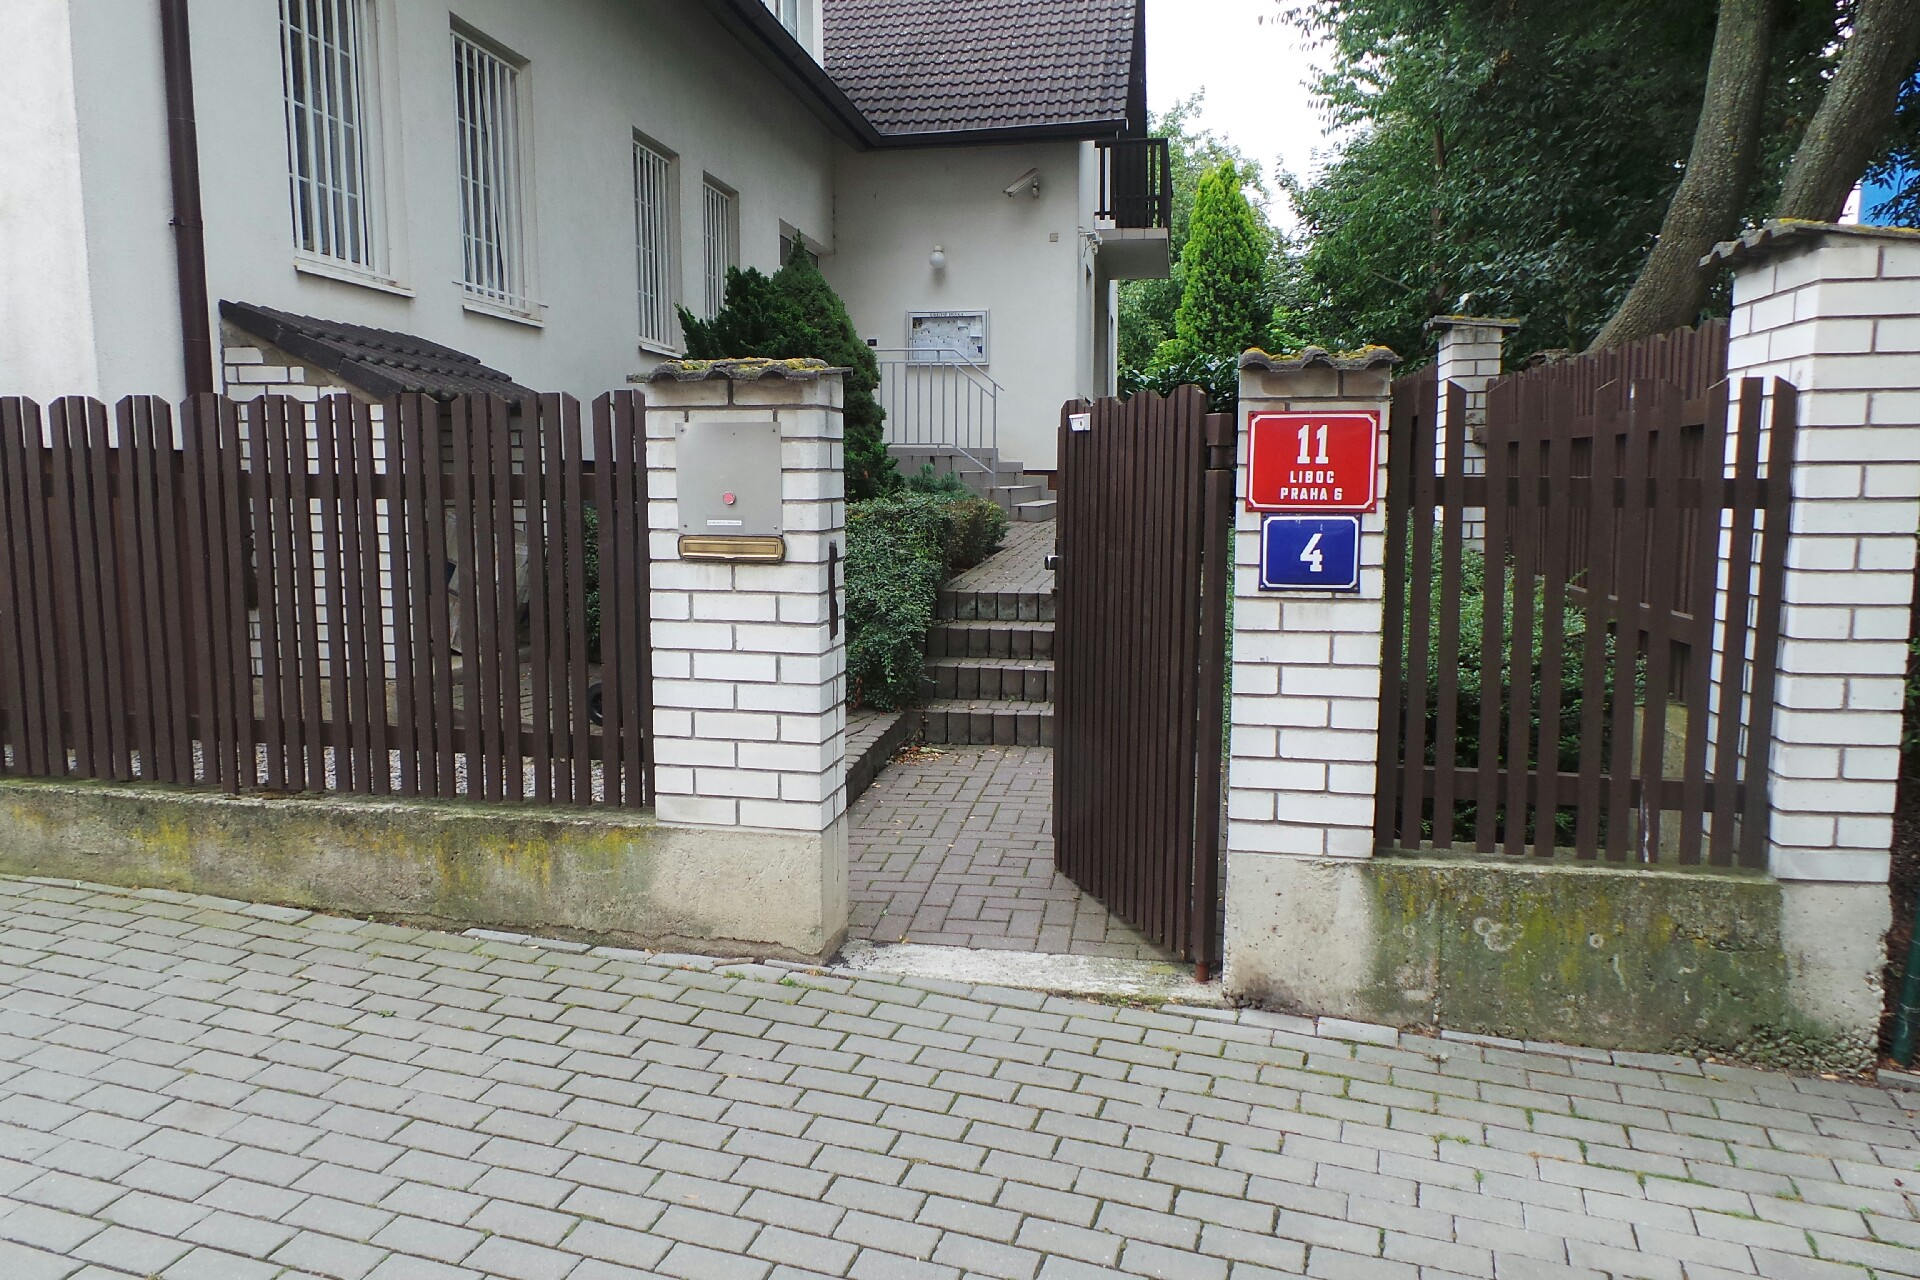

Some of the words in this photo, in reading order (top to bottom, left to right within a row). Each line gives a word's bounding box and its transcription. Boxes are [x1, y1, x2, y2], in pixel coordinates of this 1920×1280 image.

[1297, 424, 1329, 464] 11
[1289, 470, 1335, 484] LIBOC
[1280, 487, 1328, 500] PRAHA
[1333, 487, 1343, 500] 6
[1300, 533, 1323, 572] 4
